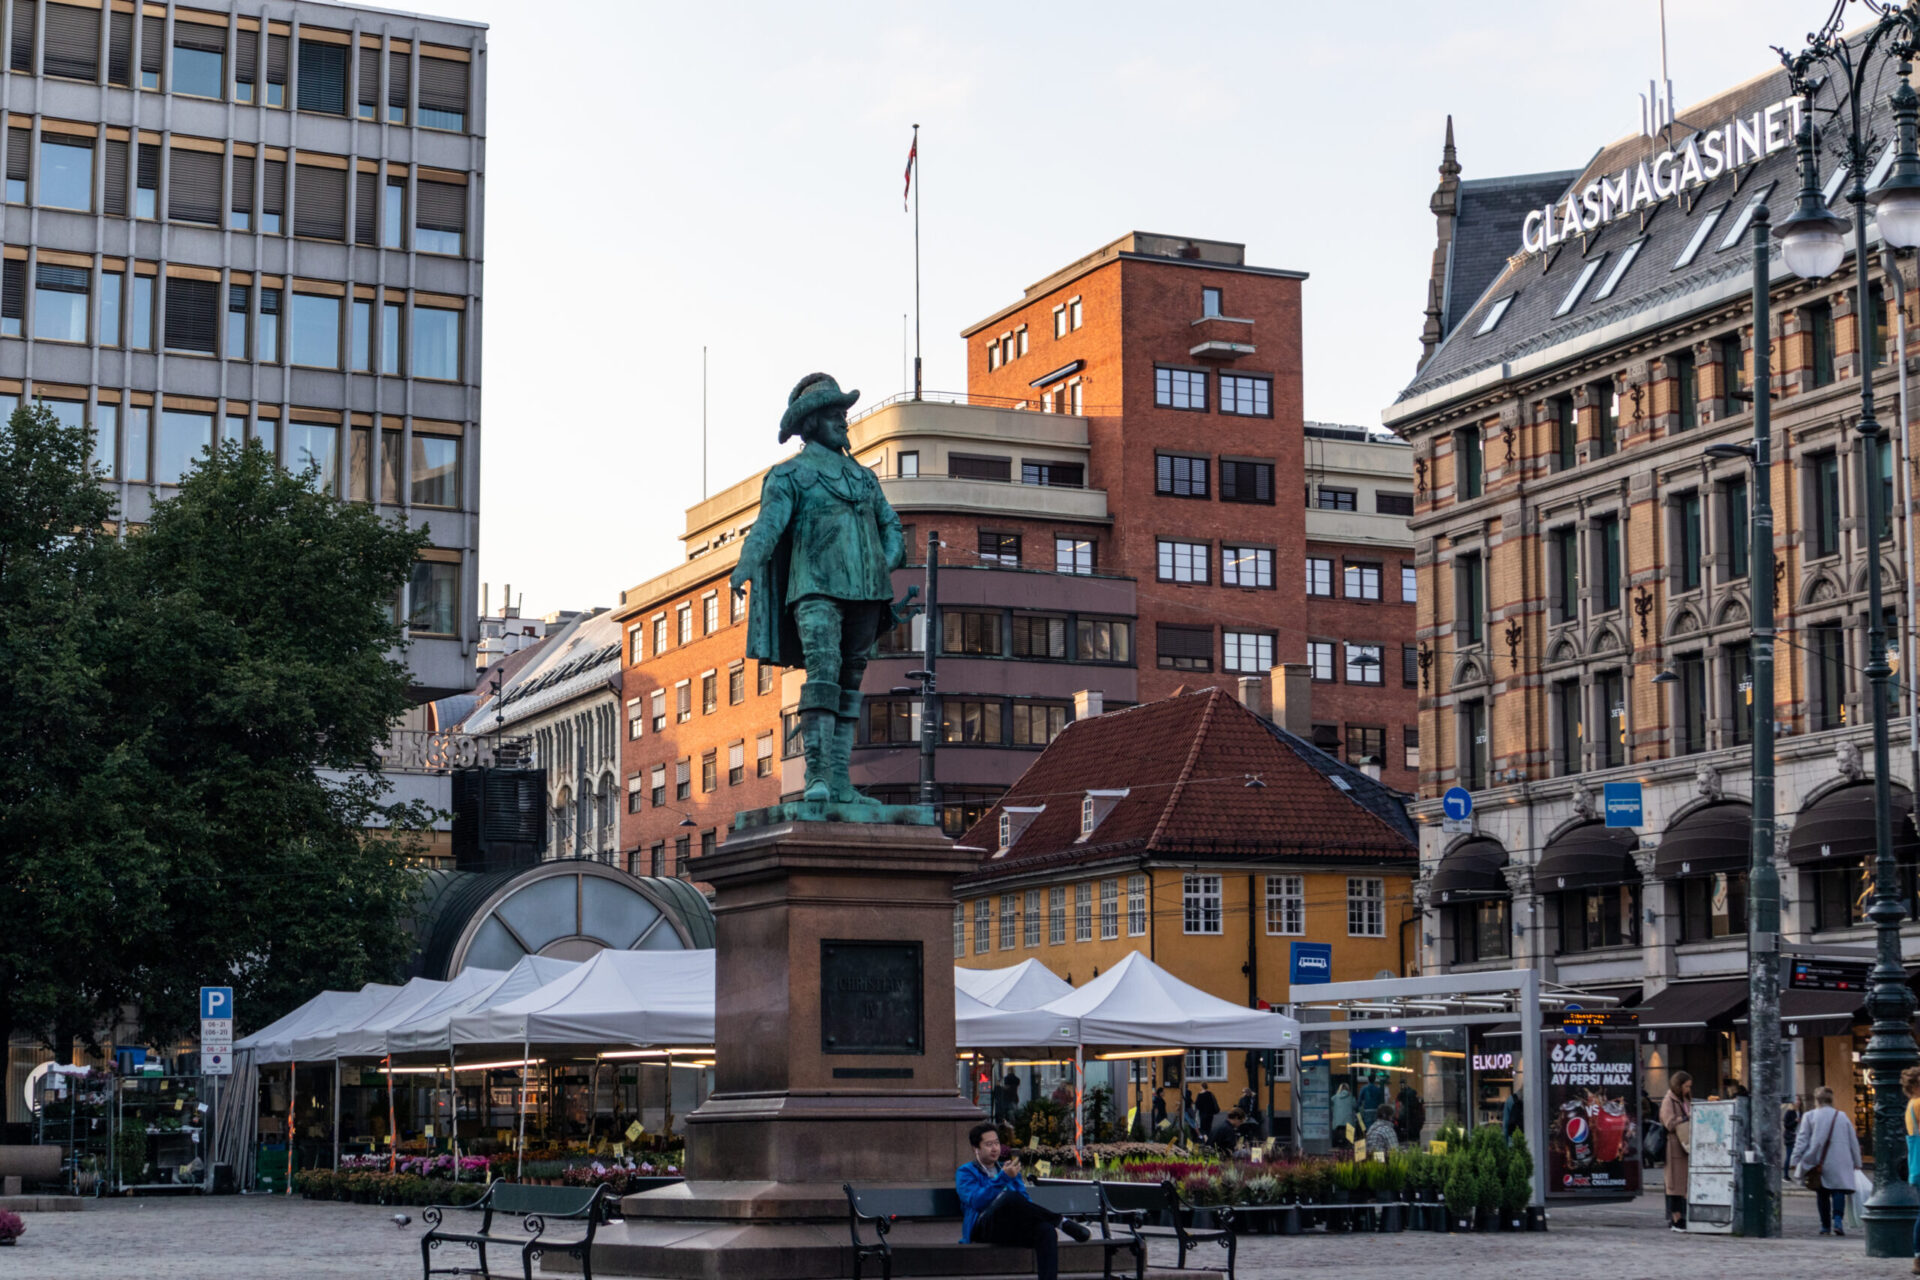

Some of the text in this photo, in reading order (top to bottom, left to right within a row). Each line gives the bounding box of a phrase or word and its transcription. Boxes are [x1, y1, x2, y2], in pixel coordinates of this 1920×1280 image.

[1522, 96, 1806, 254] GLASMAGASINET
[838, 976, 904, 992] CHRISTIAN
[208, 991, 225, 1016] P
[1551, 1063, 1632, 1073] VALGTE SMAKEN
[1551, 1074, 1633, 1085] AV PEPSI MAX.
[1585, 1104, 1600, 1117] VS
